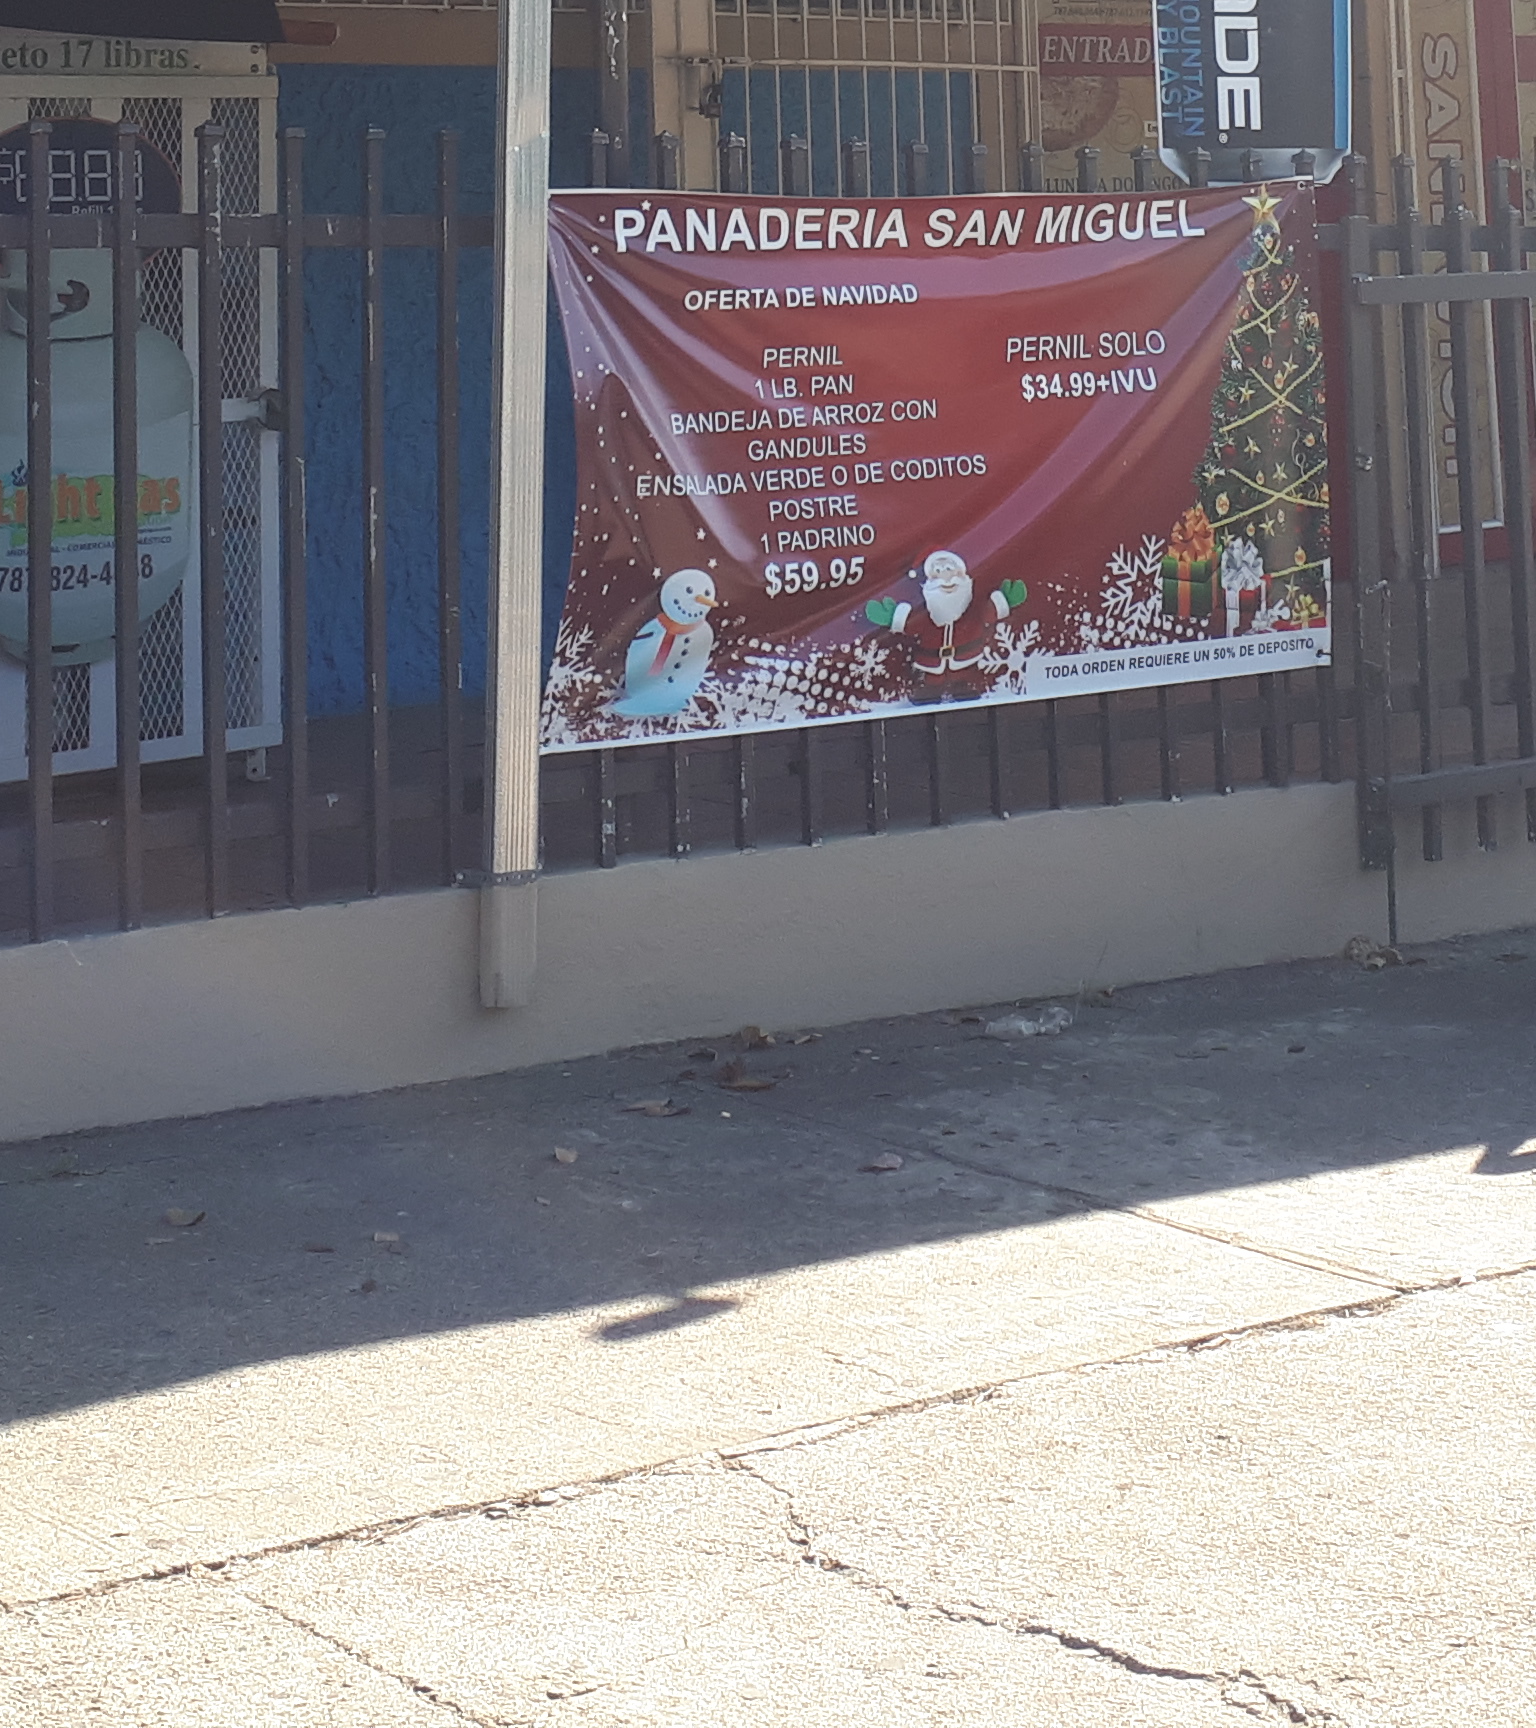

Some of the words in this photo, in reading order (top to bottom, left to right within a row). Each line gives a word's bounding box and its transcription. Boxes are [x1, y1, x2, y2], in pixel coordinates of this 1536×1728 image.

[60, 38, 93, 69] 17
[1042, 35, 1152, 63] ENTRAD
[1158, 26, 1183, 124] BLAST
[613, 207, 910, 253] PANADERIA
[923, 207, 1026, 249] SAN
[1033, 198, 1206, 244] MIGUEL
[683, 287, 780, 312] OFERTA
[784, 286, 816, 308] DE
[821, 282, 918, 306] NAVIDAD
[762, 344, 844, 369] PERNIL
[1005, 333, 1093, 363] PERNIL
[1097, 329, 1166, 358] SOLO
[754, 378, 765, 400] 1
[770, 376, 804, 400] LB.
[810, 374, 854, 397] PAN
[1020, 366, 1158, 403] $34.99+IVU
[670, 409, 774, 436] BANDEJA
[777, 406, 808, 430] DE
[812, 401, 885, 427] ARROZ
[890, 398, 938, 422] CON
[747, 432, 868, 462] GANDULES
[635, 471, 748, 498] ENSALADA
[750, 466, 825, 493] VERDE
[831, 464, 849, 487] O
[854, 461, 885, 485] DE
[889, 454, 988, 482] CODITOS
[138, 476, 181, 514] as
[768, 493, 859, 522] POSTRE
[760, 533, 771, 555] 1
[777, 523, 876, 553] PADRINO
[763, 555, 866, 600] $59.95
[1044, 664, 1079, 680] TODA
[1081, 660, 1125, 677] ORDEN
[1128, 651, 1190, 671] REQUIERE
[1193, 648, 1211, 663] UN
[1212, 645, 1237, 661] 50%
[1239, 643, 1256, 658] DE
[1257, 637, 1315, 656] DEPOSITO
